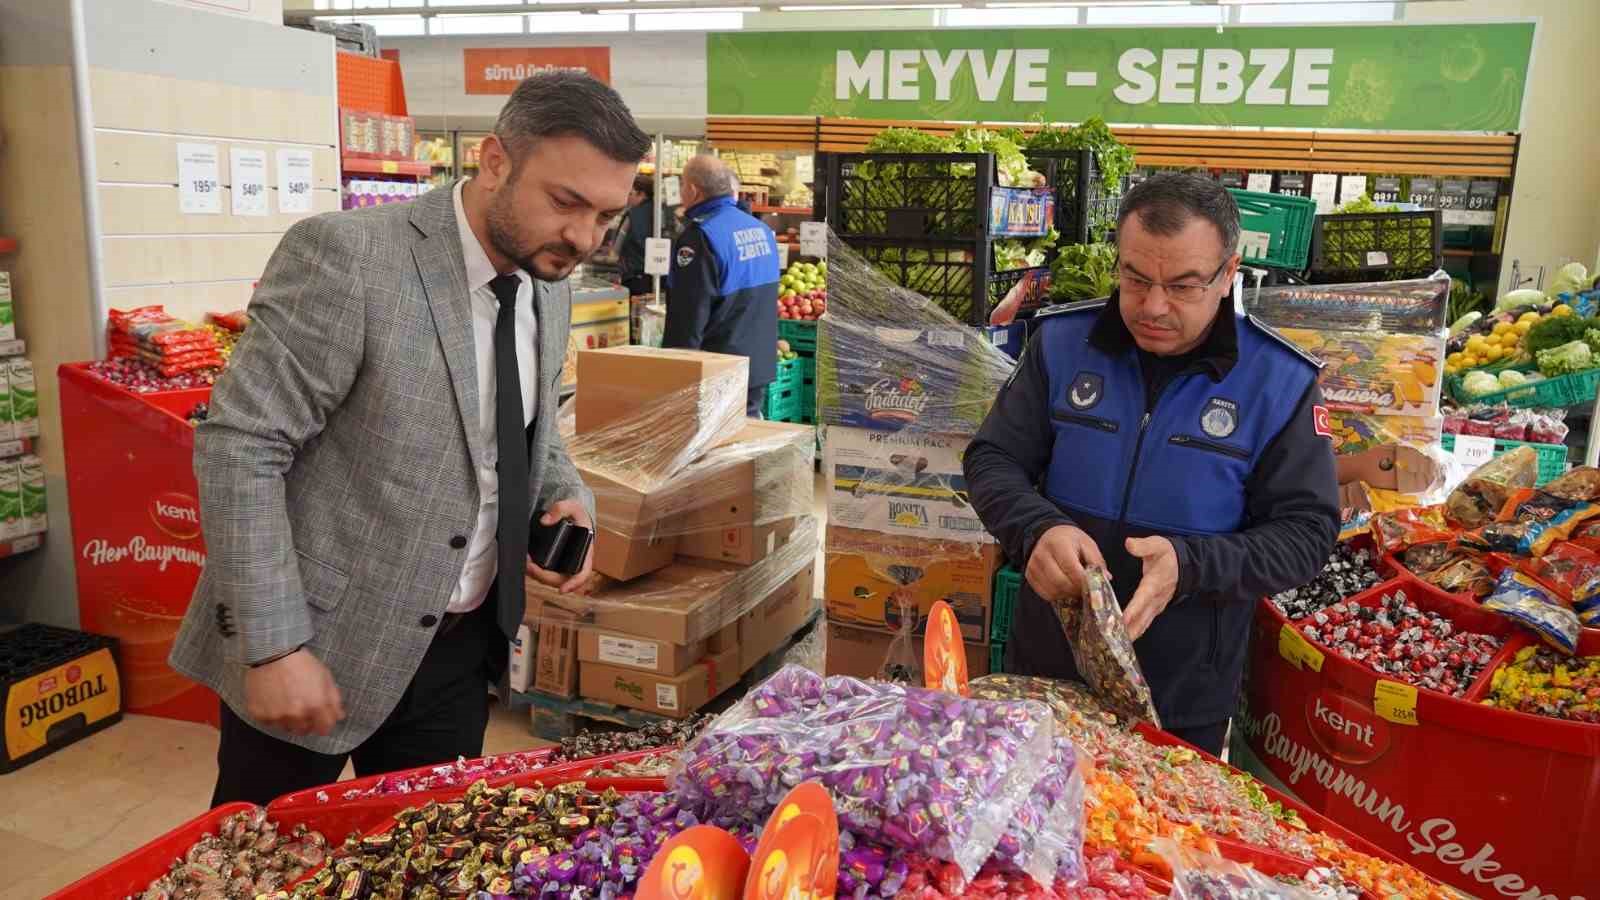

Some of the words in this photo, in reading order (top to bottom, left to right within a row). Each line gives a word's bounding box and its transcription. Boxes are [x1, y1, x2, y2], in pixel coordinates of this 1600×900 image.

[484, 63, 525, 81] SÜTLÜ
[835, 47, 1050, 102] MEYVE
[1066, 71, 1097, 86] -
[1112, 47, 1335, 106] SEBZE
[155, 500, 199, 523] kent
[887, 500, 929, 524] BONITA
[82, 538, 129, 567] Her
[19, 673, 107, 729] TUBORG
[1314, 697, 1375, 747] kent
[1263, 711, 1412, 833] Bayramın
